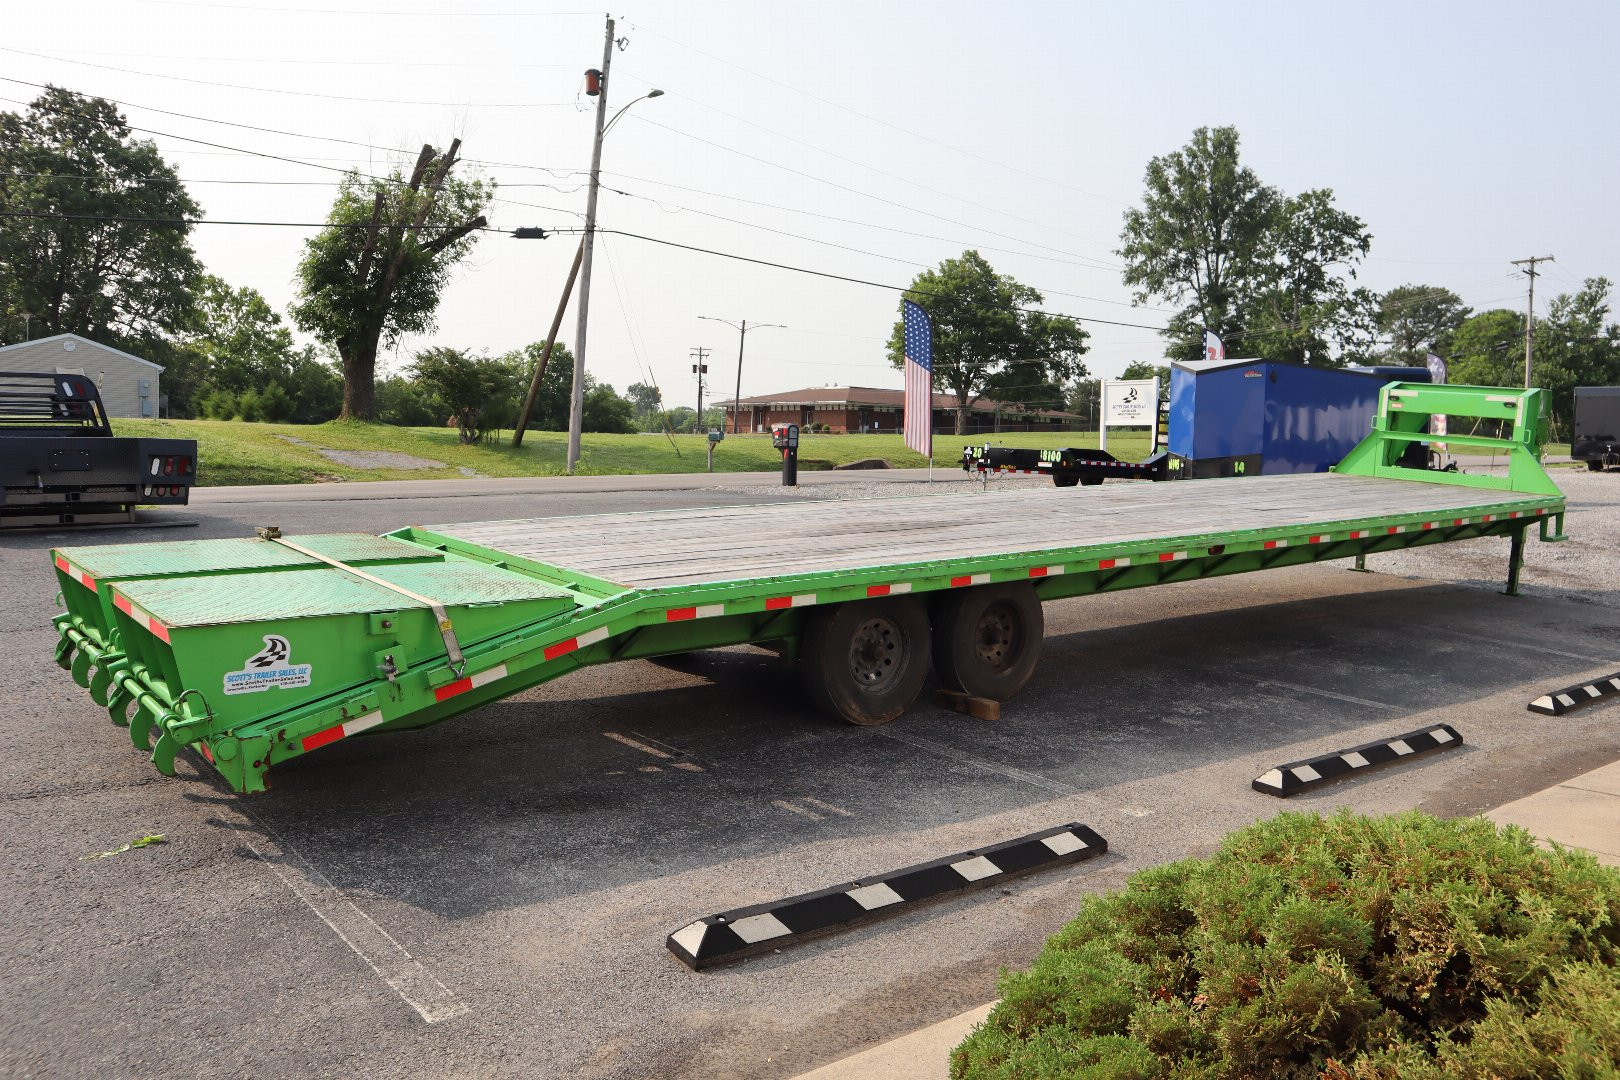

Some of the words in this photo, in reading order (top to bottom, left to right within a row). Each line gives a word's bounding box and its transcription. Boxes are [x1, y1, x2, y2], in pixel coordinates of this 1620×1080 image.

[973, 447, 982, 458] 20
[1234, 461, 1245, 473] 14
[227, 672, 253, 683] SCOTT'S
[254, 671, 277, 680] TRAILER
[278, 668, 297, 677] SALES,
[298, 667, 308, 675] LLC
